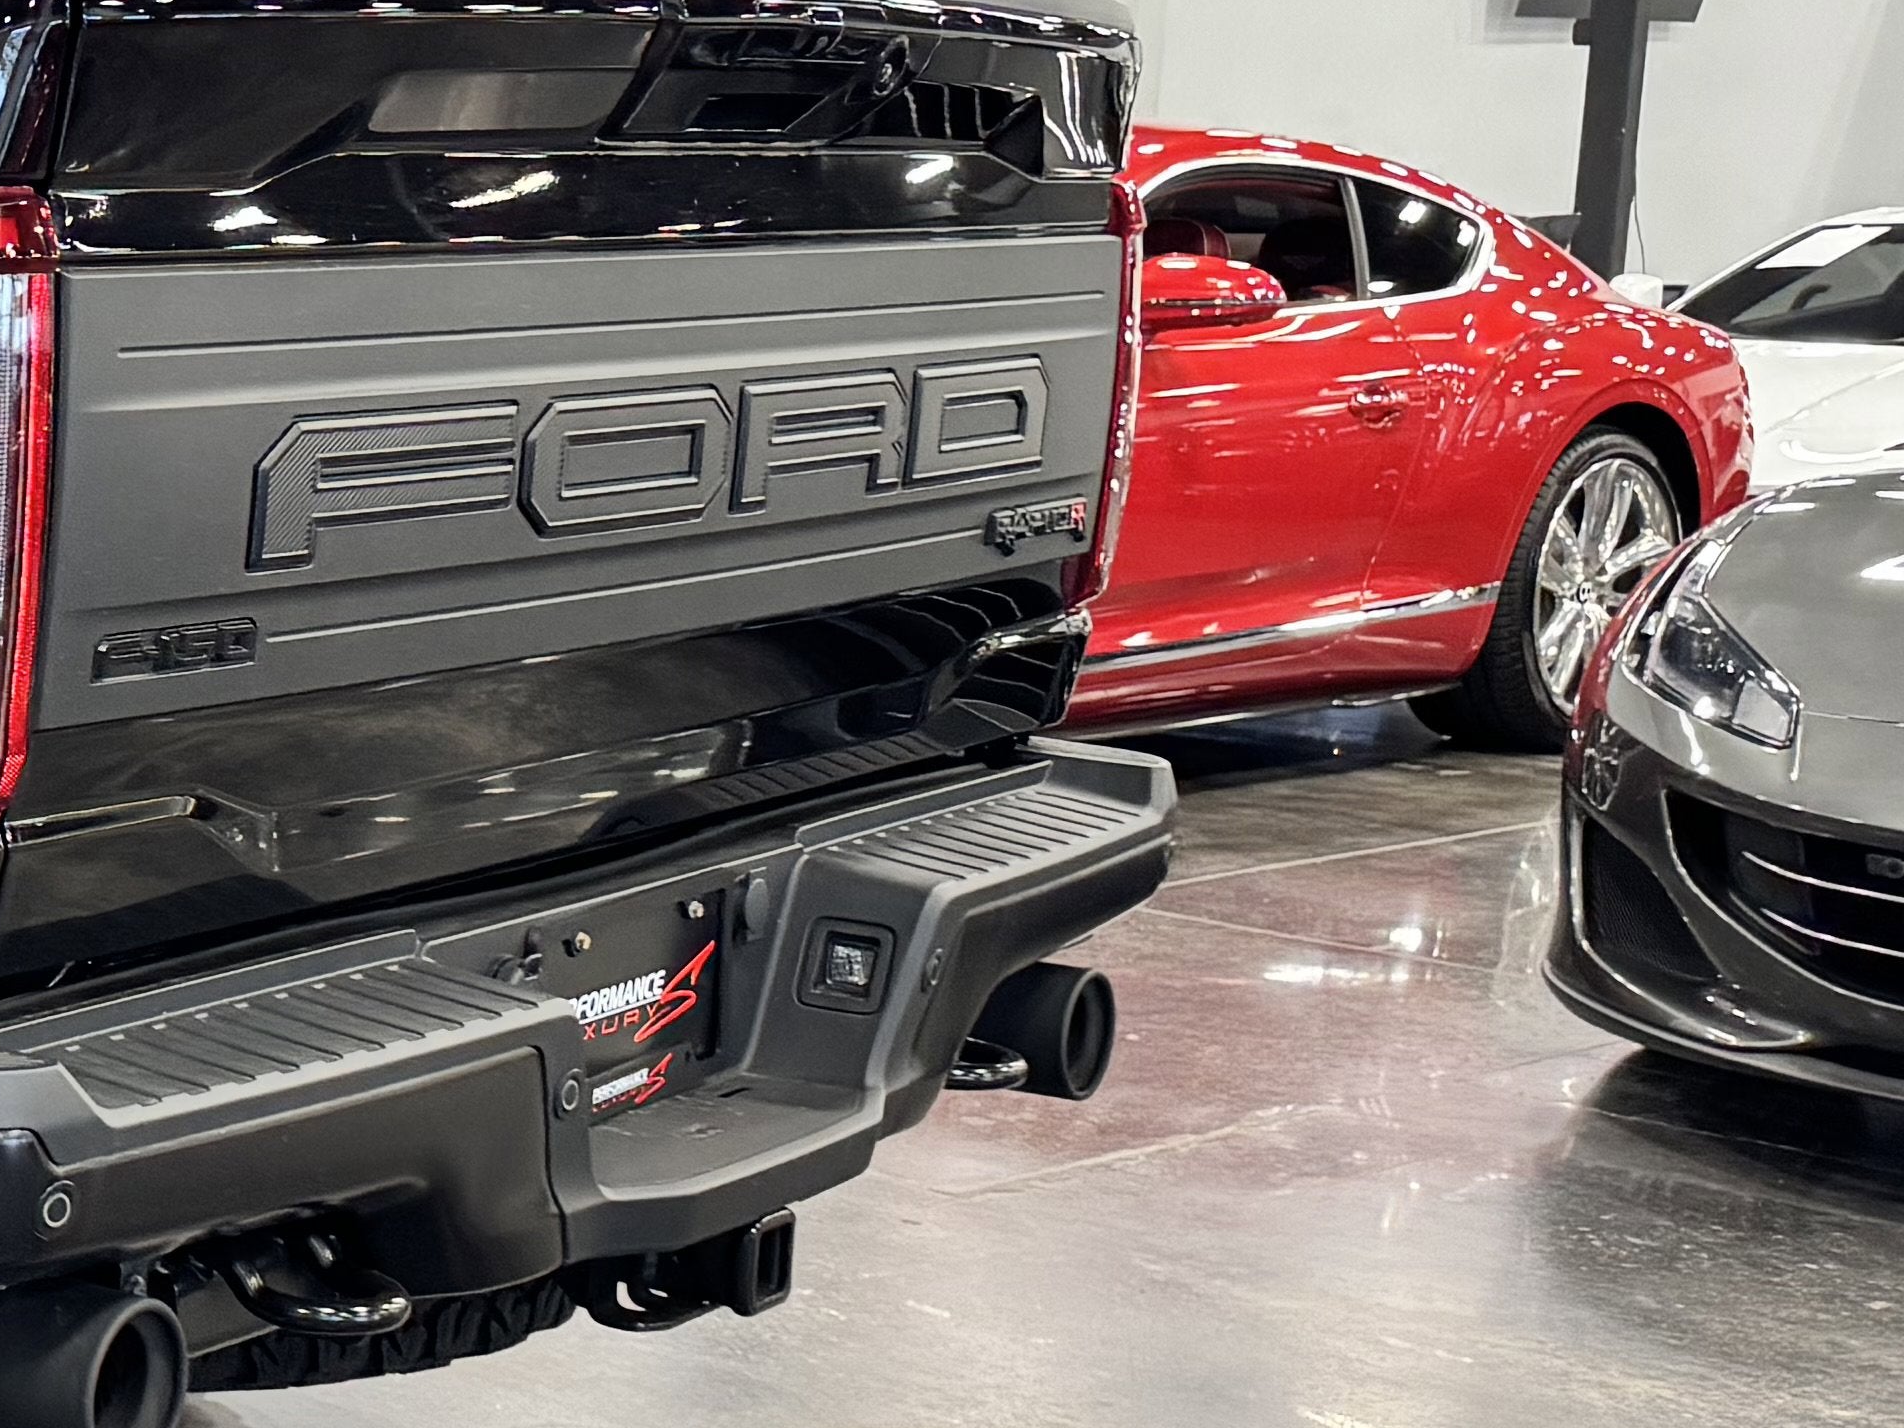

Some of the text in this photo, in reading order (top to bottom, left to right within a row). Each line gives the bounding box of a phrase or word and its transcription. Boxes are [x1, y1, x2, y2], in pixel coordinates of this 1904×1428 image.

[245, 353, 1050, 575] FORD
[569, 969, 667, 1020] FORMANCE
[583, 1002, 661, 1041] XURY
